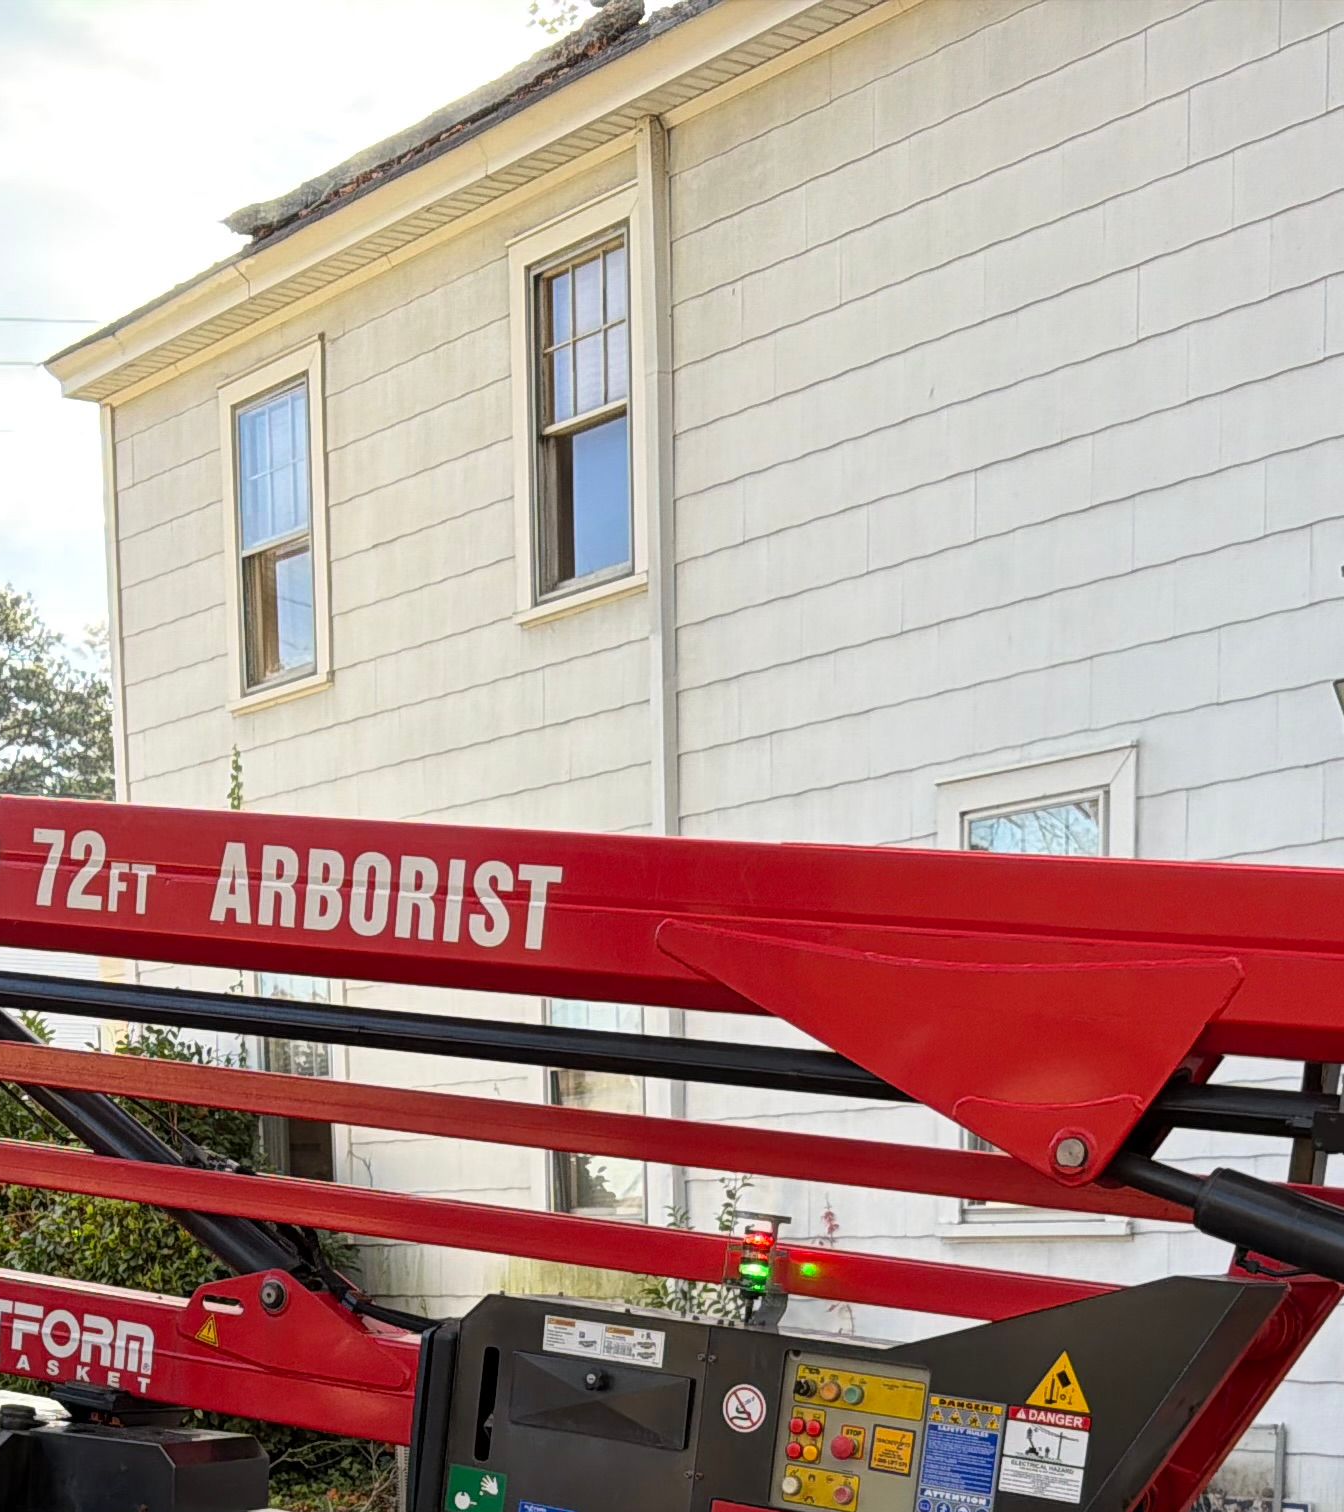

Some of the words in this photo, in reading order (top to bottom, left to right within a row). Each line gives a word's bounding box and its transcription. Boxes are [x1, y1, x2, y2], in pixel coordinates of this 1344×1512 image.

[209, 841, 563, 950] ARBORIST
[1028, 1409, 1083, 1428] DANGER
[846, 1428, 862, 1436] STOP
[924, 1489, 987, 1506] ATTENTION
